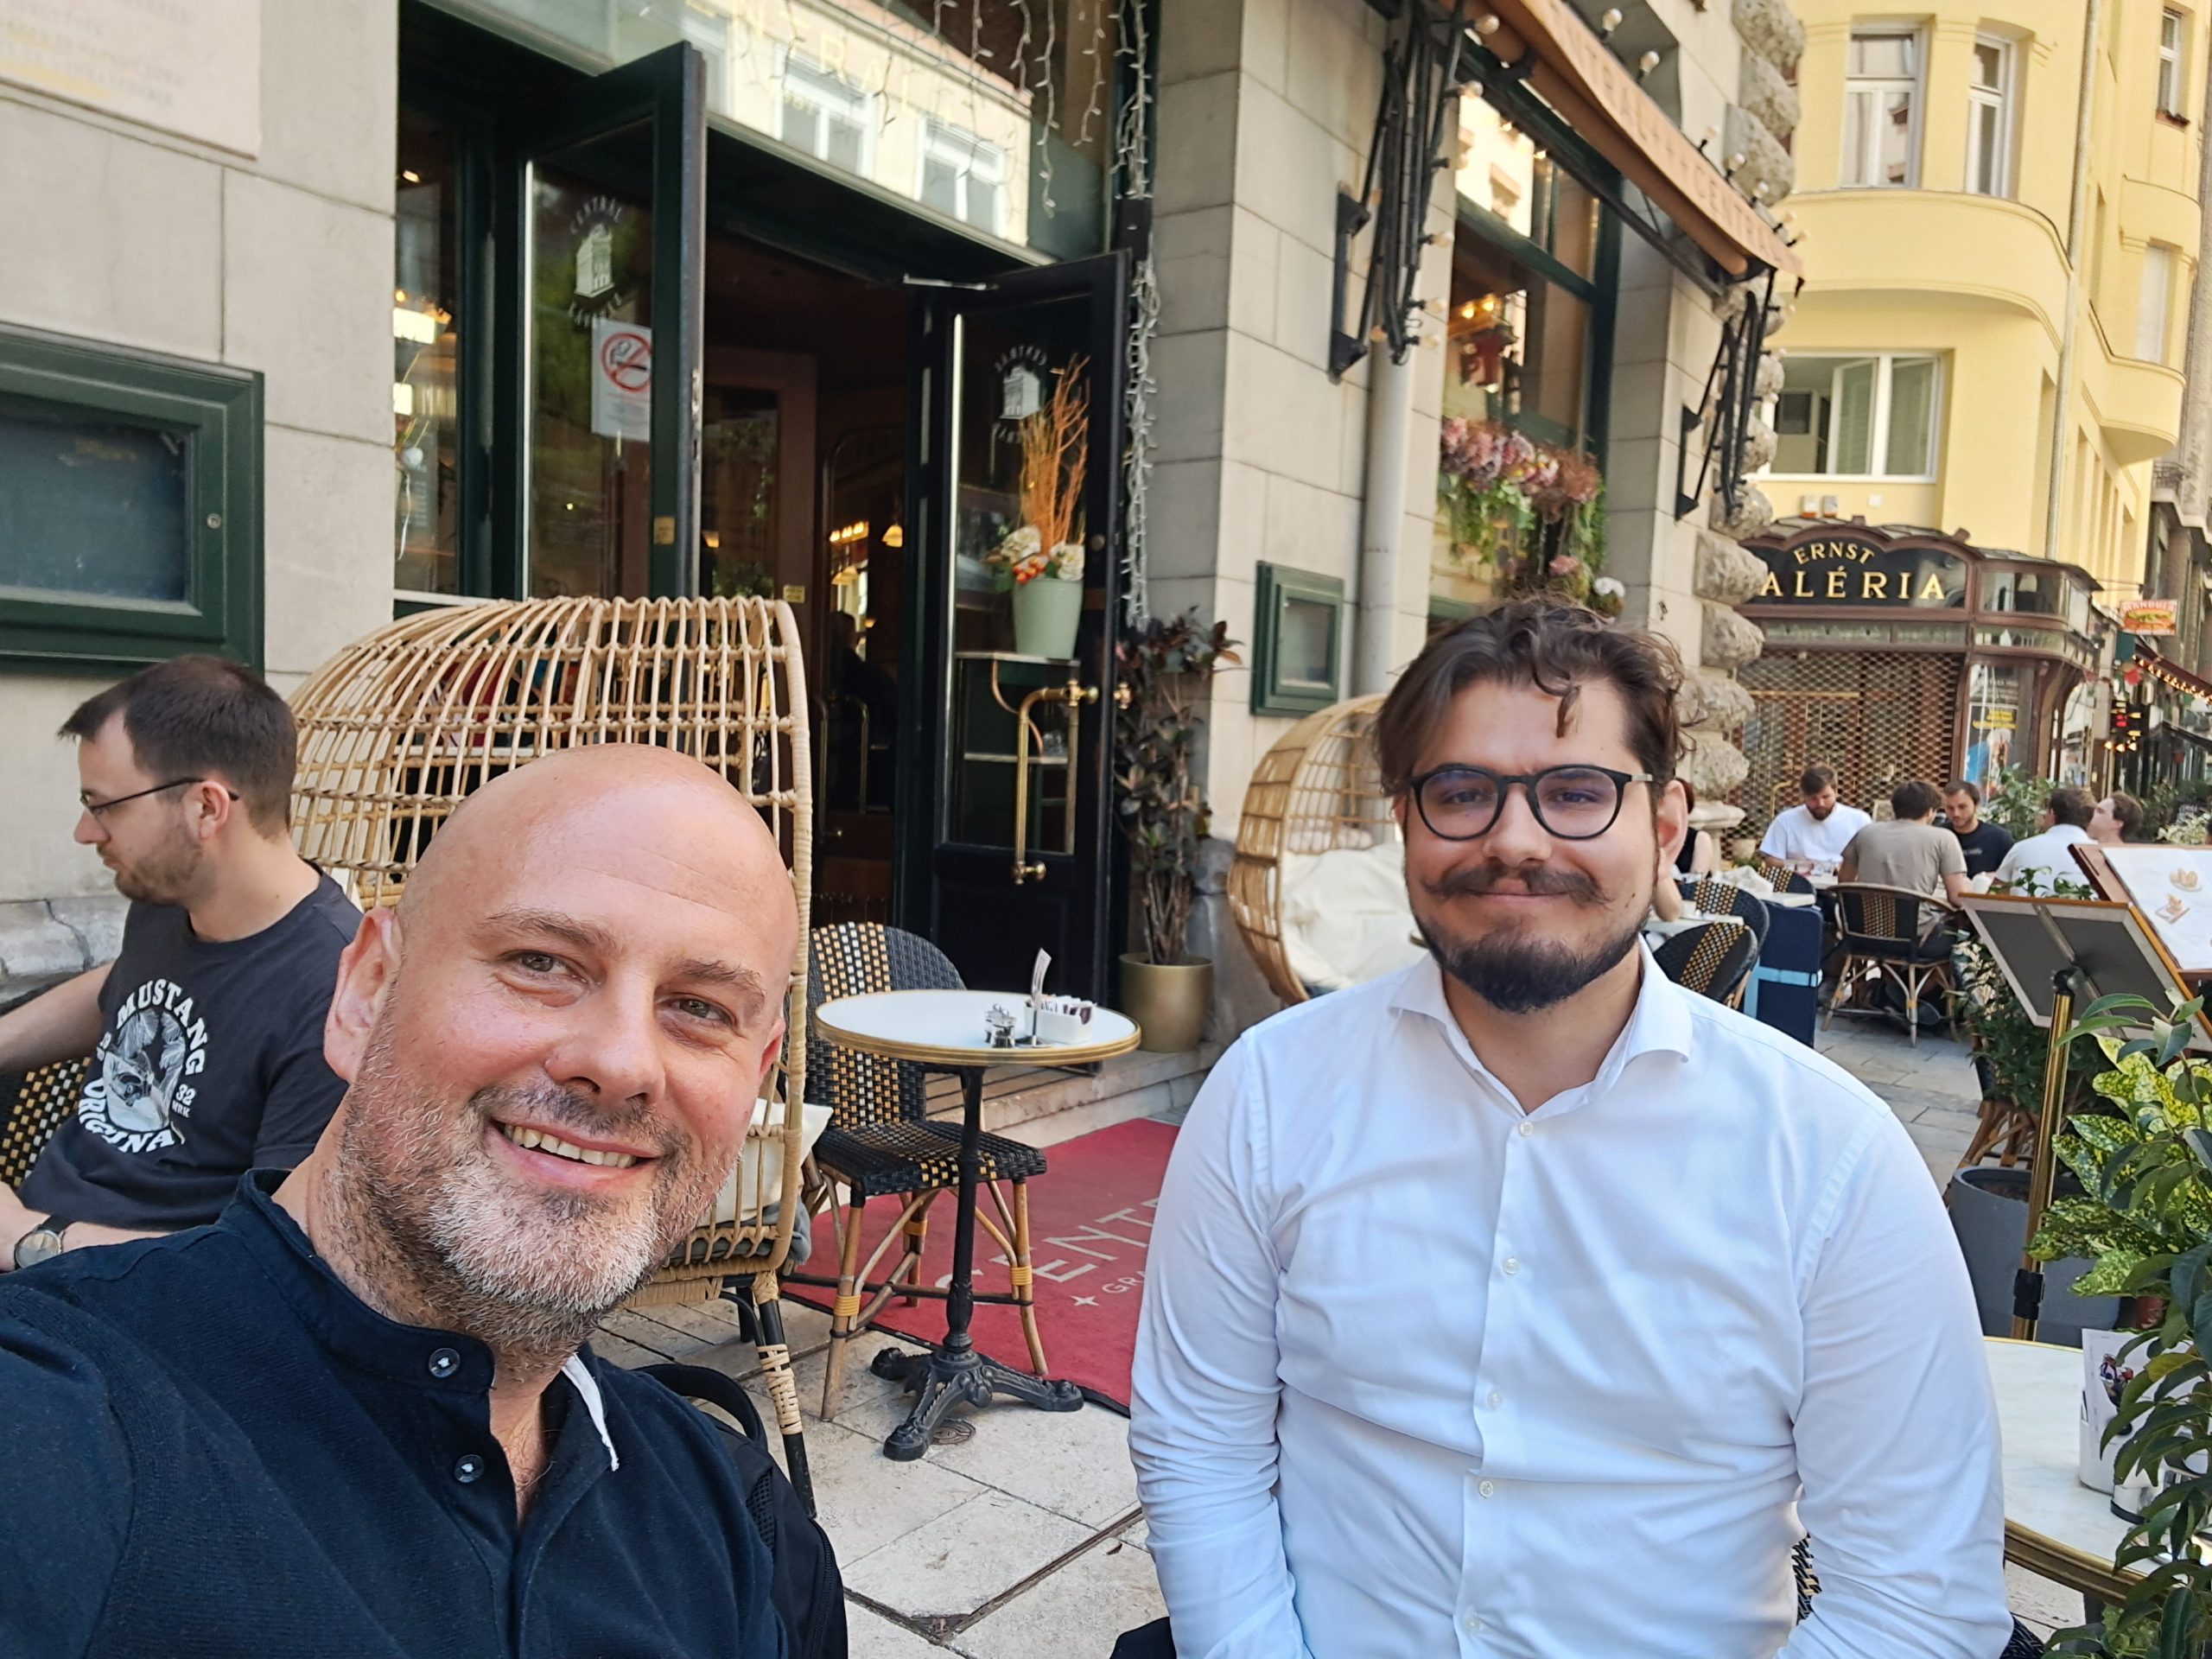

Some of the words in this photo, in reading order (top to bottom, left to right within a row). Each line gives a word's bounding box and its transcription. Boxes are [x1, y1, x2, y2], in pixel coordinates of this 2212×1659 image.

[1794, 541, 1874, 565] ERNST
[1760, 565, 1945, 600] ALÉRIA
[117, 979, 207, 1075] MUSTANG
[79, 1078, 185, 1154] ORIGINA
[175, 1084, 196, 1106] 32
[935, 1195, 1159, 1306] ENT
